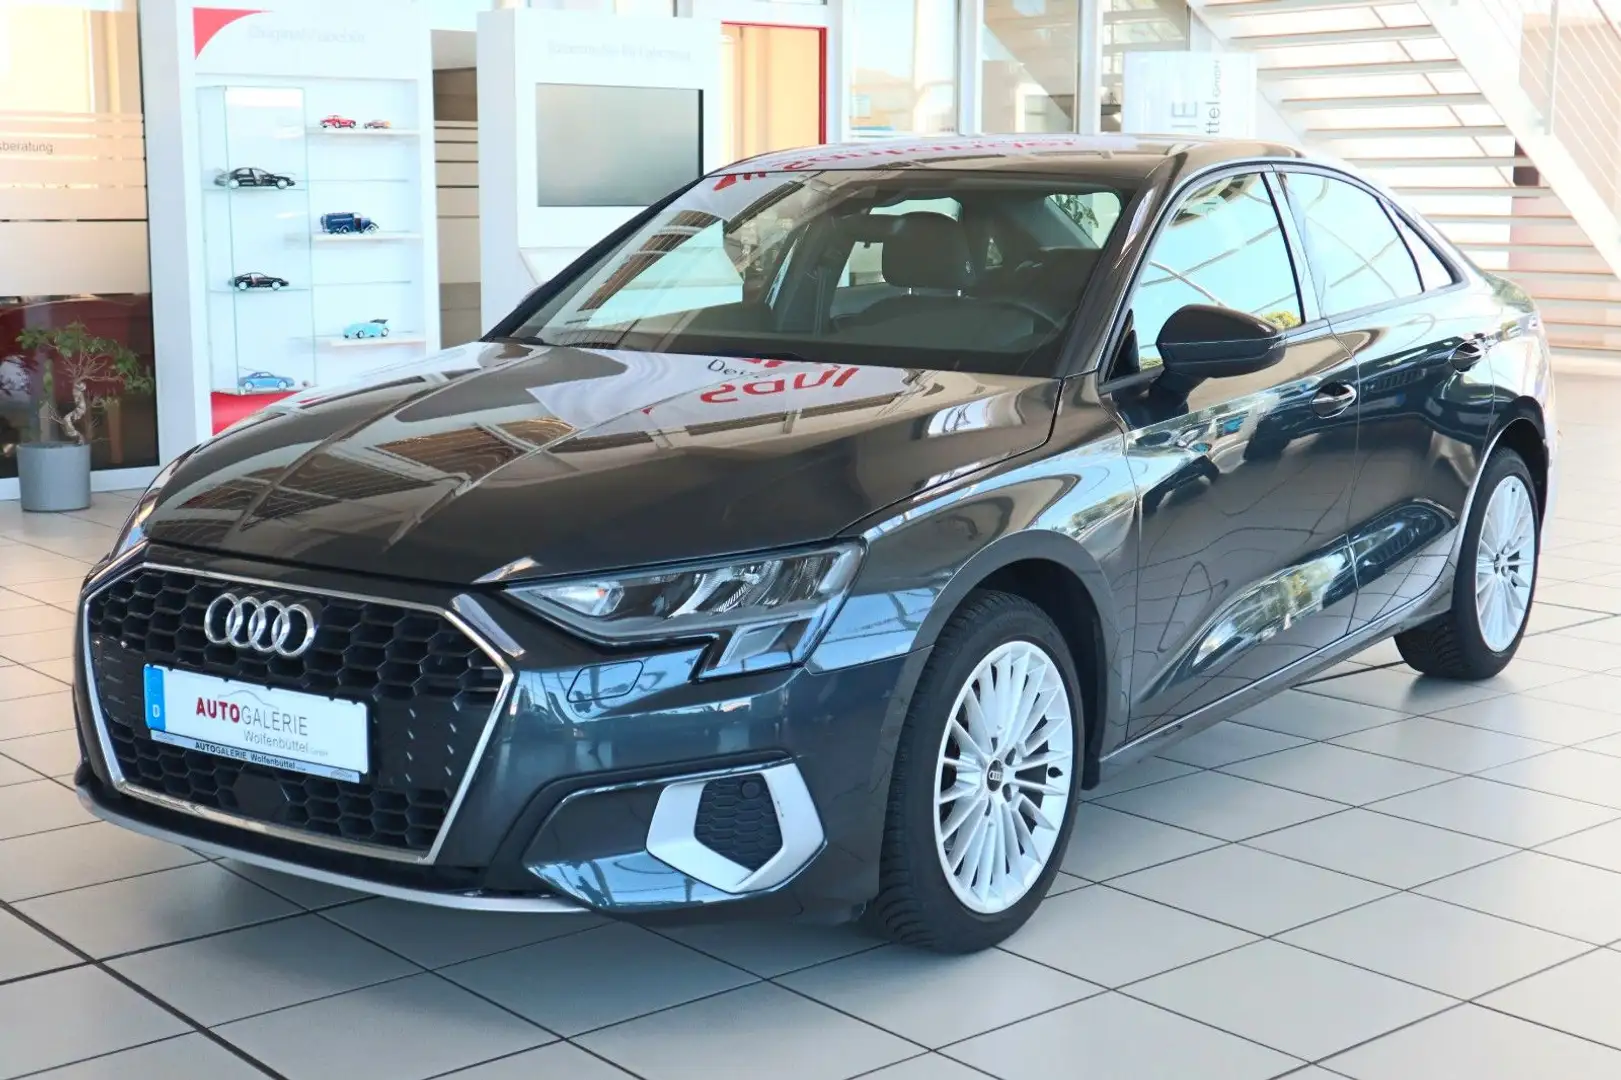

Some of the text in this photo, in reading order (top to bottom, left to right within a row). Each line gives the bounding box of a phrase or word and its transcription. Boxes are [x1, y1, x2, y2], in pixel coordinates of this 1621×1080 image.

[152, 704, 161, 718] D
[196, 697, 308, 736] AUTOGALERIE
[195, 741, 248, 761] AUTOGALERIE
